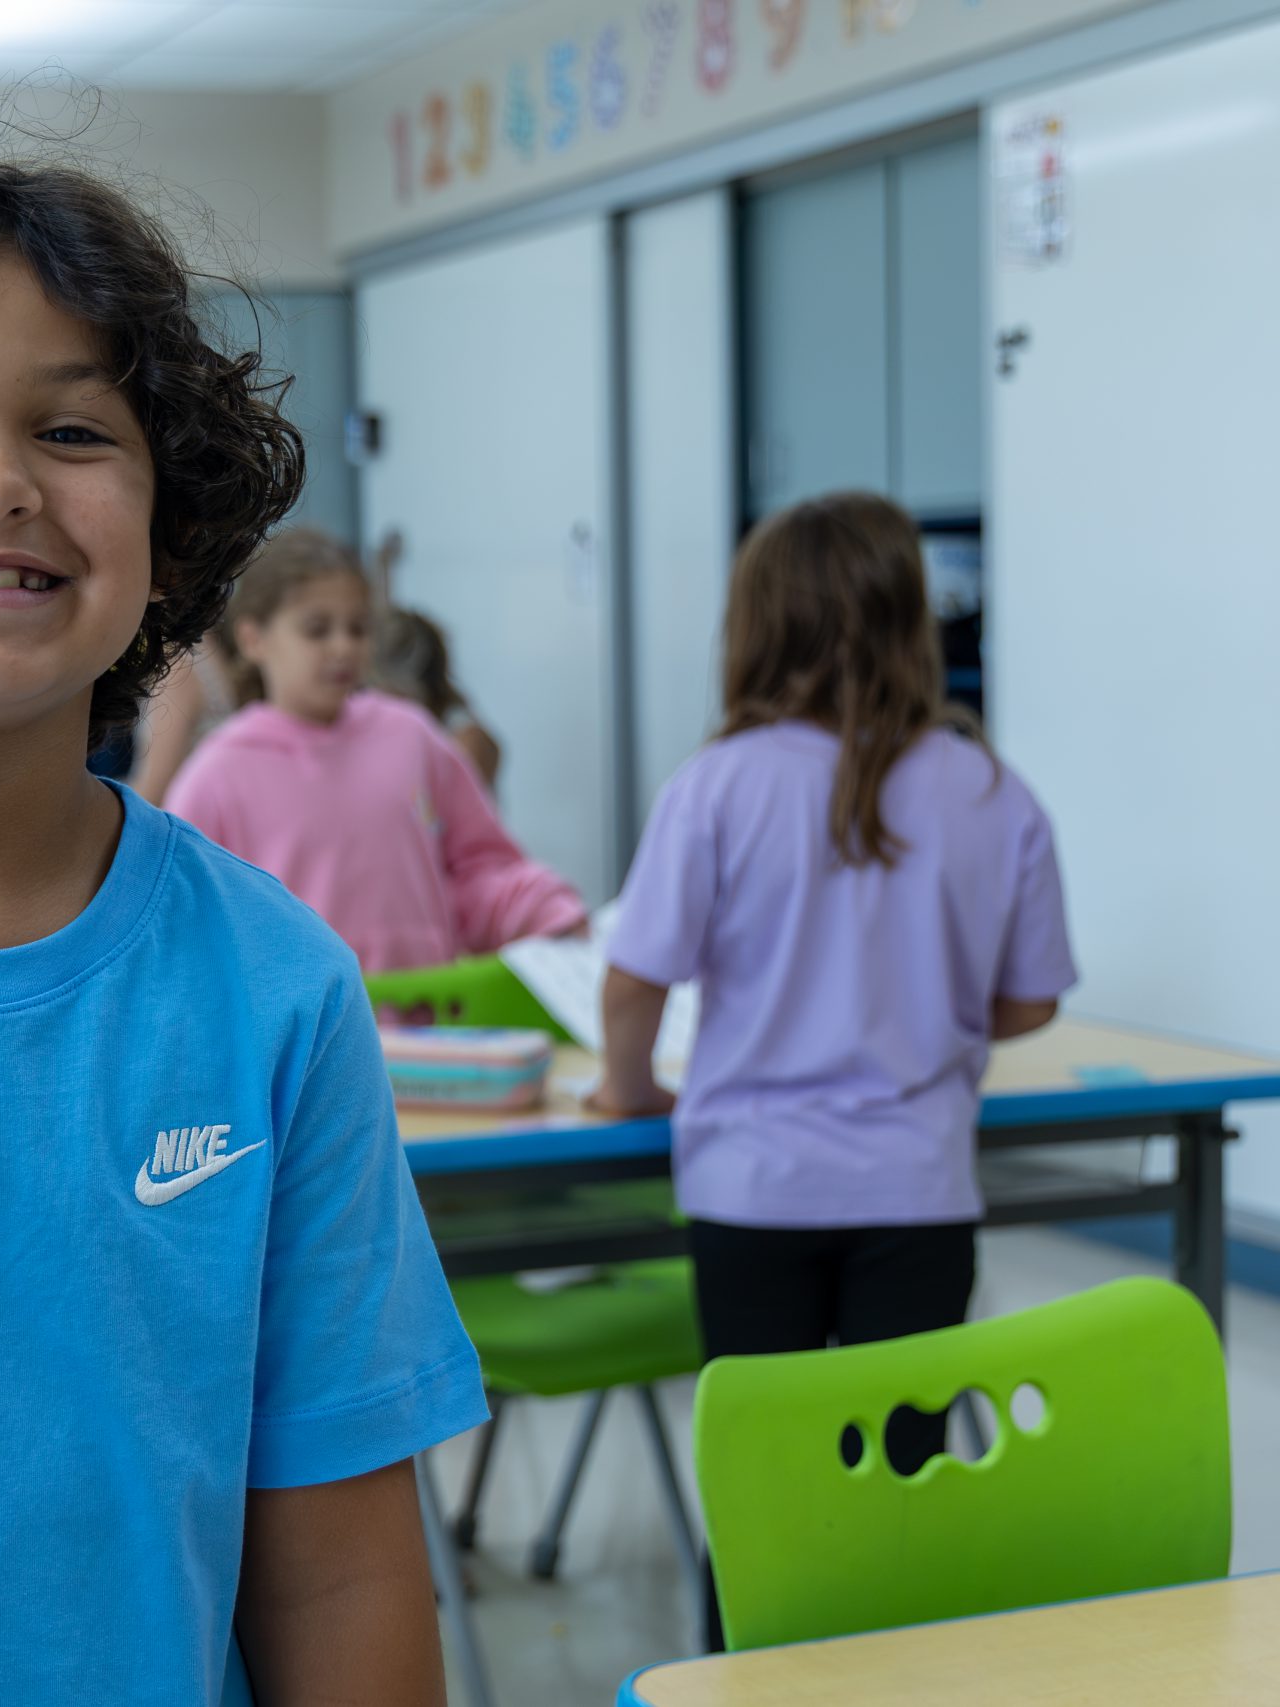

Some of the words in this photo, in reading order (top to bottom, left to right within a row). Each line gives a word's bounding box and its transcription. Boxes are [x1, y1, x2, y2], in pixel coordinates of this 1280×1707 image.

[421, 89, 453, 191] 2
[462, 80, 491, 180] 3
[545, 38, 579, 152] 5
[590, 22, 627, 129] 6
[696, 0, 734, 96] 8
[151, 1124, 232, 1175] NIKE
